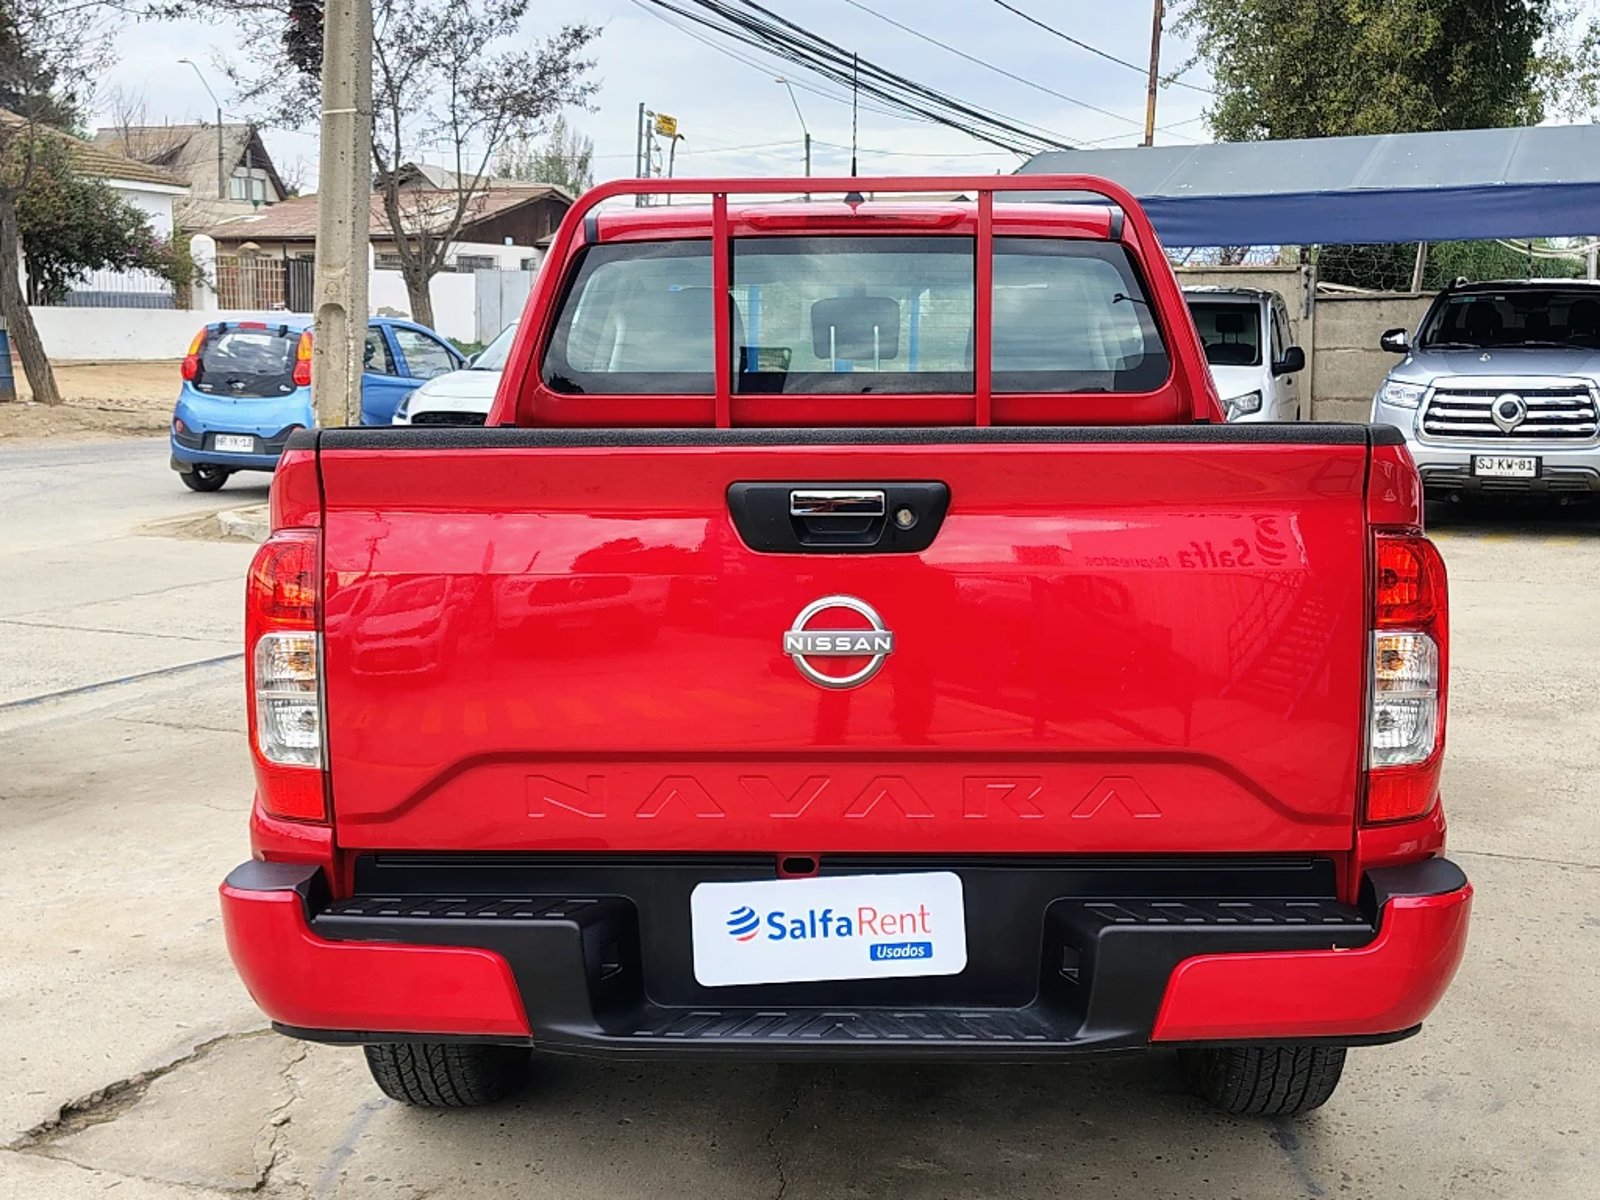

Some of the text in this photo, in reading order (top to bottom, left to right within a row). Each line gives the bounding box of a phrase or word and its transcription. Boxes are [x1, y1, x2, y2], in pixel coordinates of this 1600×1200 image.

[786, 636, 891, 651] NISSAN
[525, 774, 1163, 819] NAVARA
[876, 943, 926, 959] Usados
